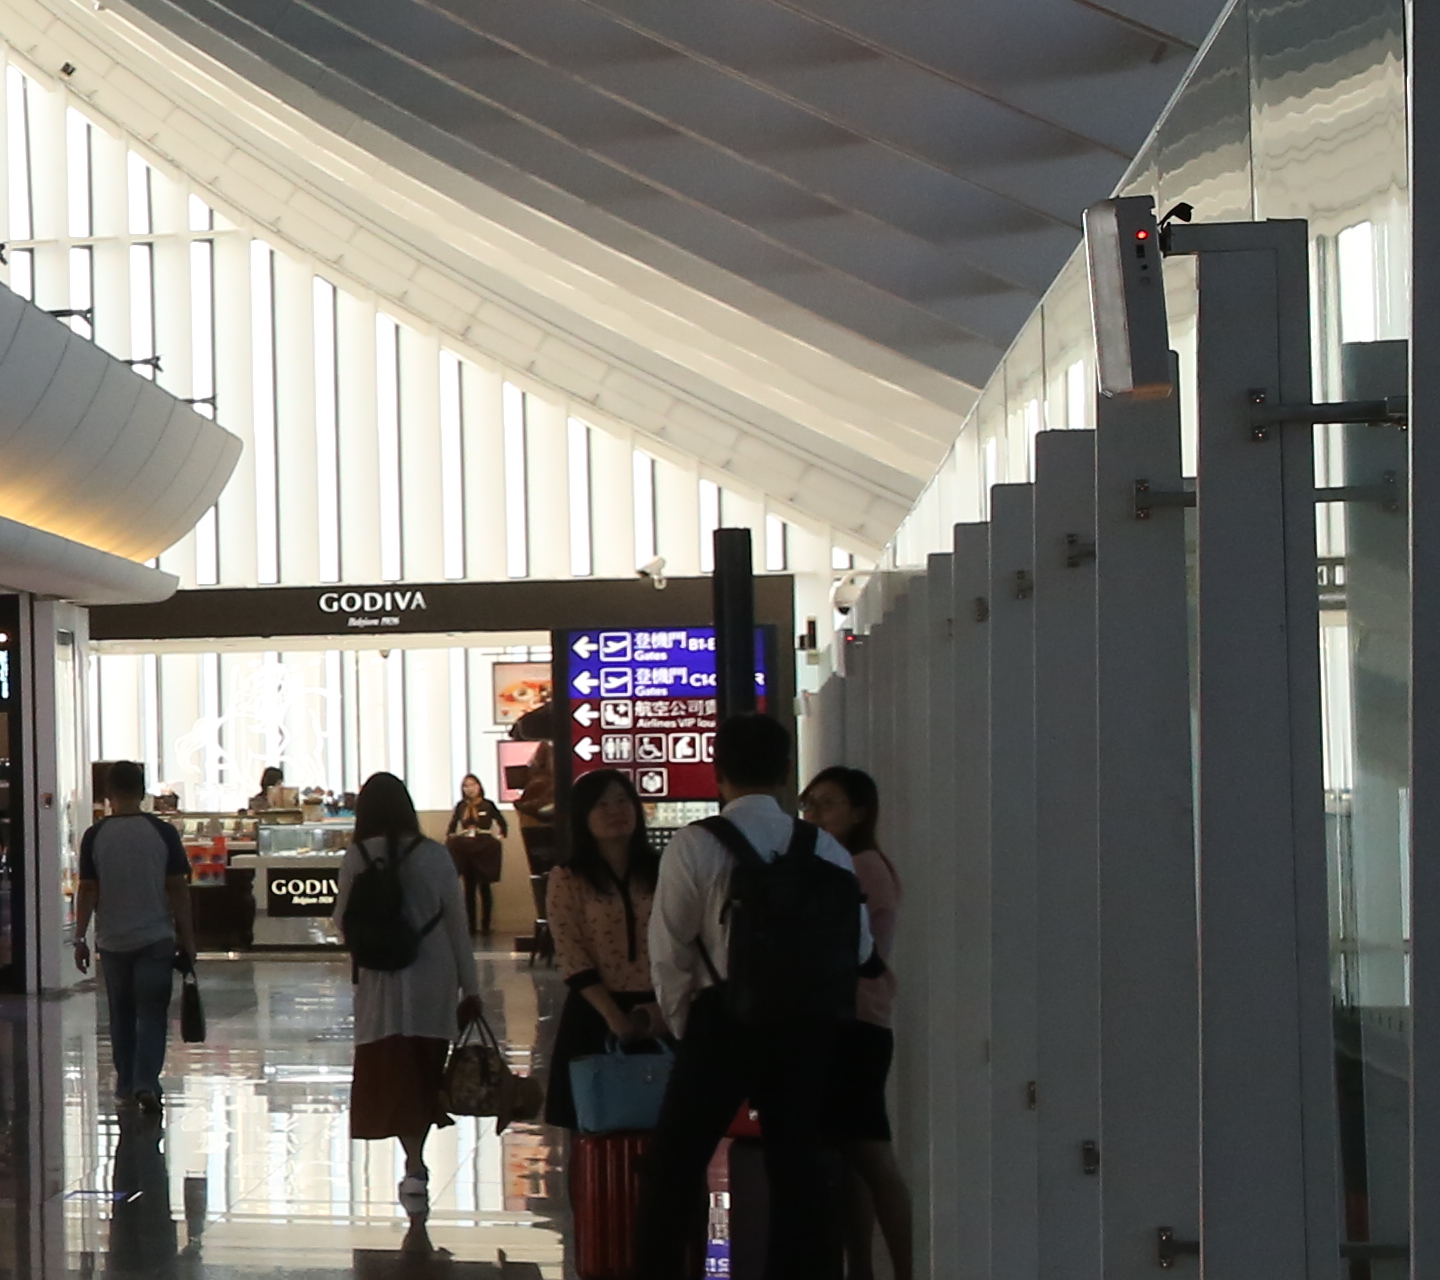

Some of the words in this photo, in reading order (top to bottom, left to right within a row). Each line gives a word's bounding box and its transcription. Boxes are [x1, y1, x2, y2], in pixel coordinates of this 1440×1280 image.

[319, 590, 427, 614] GODIVA
[634, 631, 687, 649] 登機門
[634, 650, 668, 661] Gates
[634, 667, 688, 685] 登機門
[635, 686, 668, 696] Gates
[635, 699, 716, 717] 航空公司貴
[636, 717, 677, 728] Airlines
[678, 718, 696, 727] VIP
[697, 717, 716, 728] lou
[271, 879, 339, 896] GODIV
